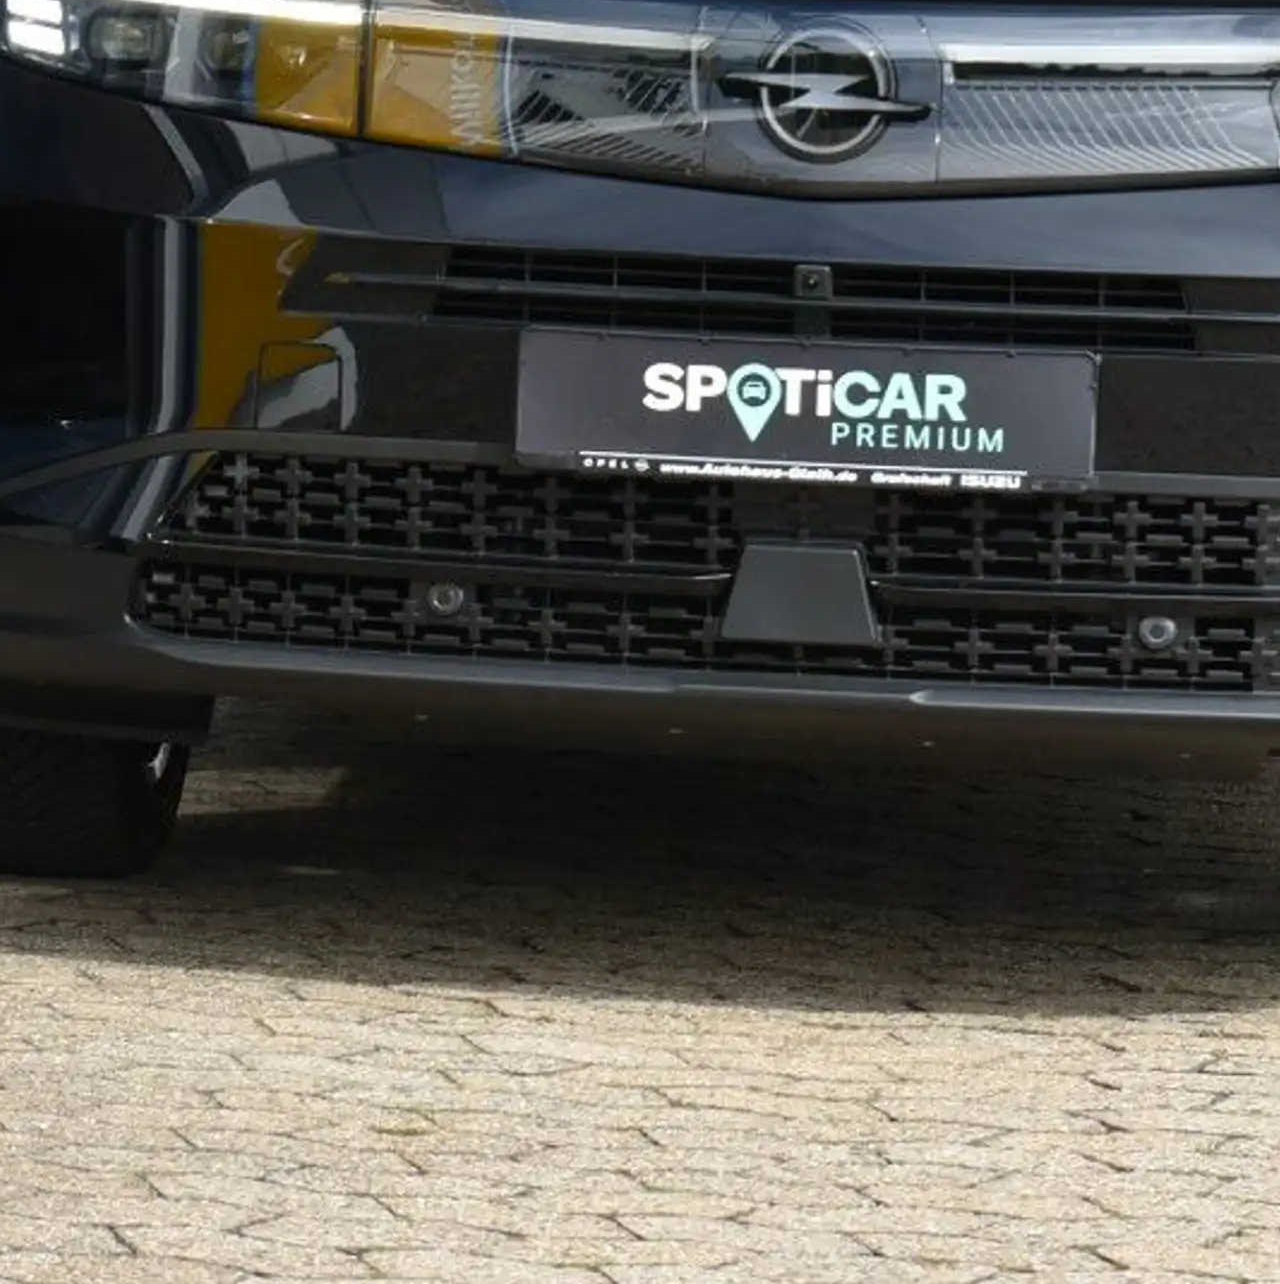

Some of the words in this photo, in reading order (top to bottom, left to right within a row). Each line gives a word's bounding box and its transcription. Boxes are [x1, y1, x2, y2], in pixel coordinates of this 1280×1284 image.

[830, 422, 1004, 453] PREMIUM
[582, 457, 629, 470] OPEL
[960, 474, 1021, 489] ISUZU
